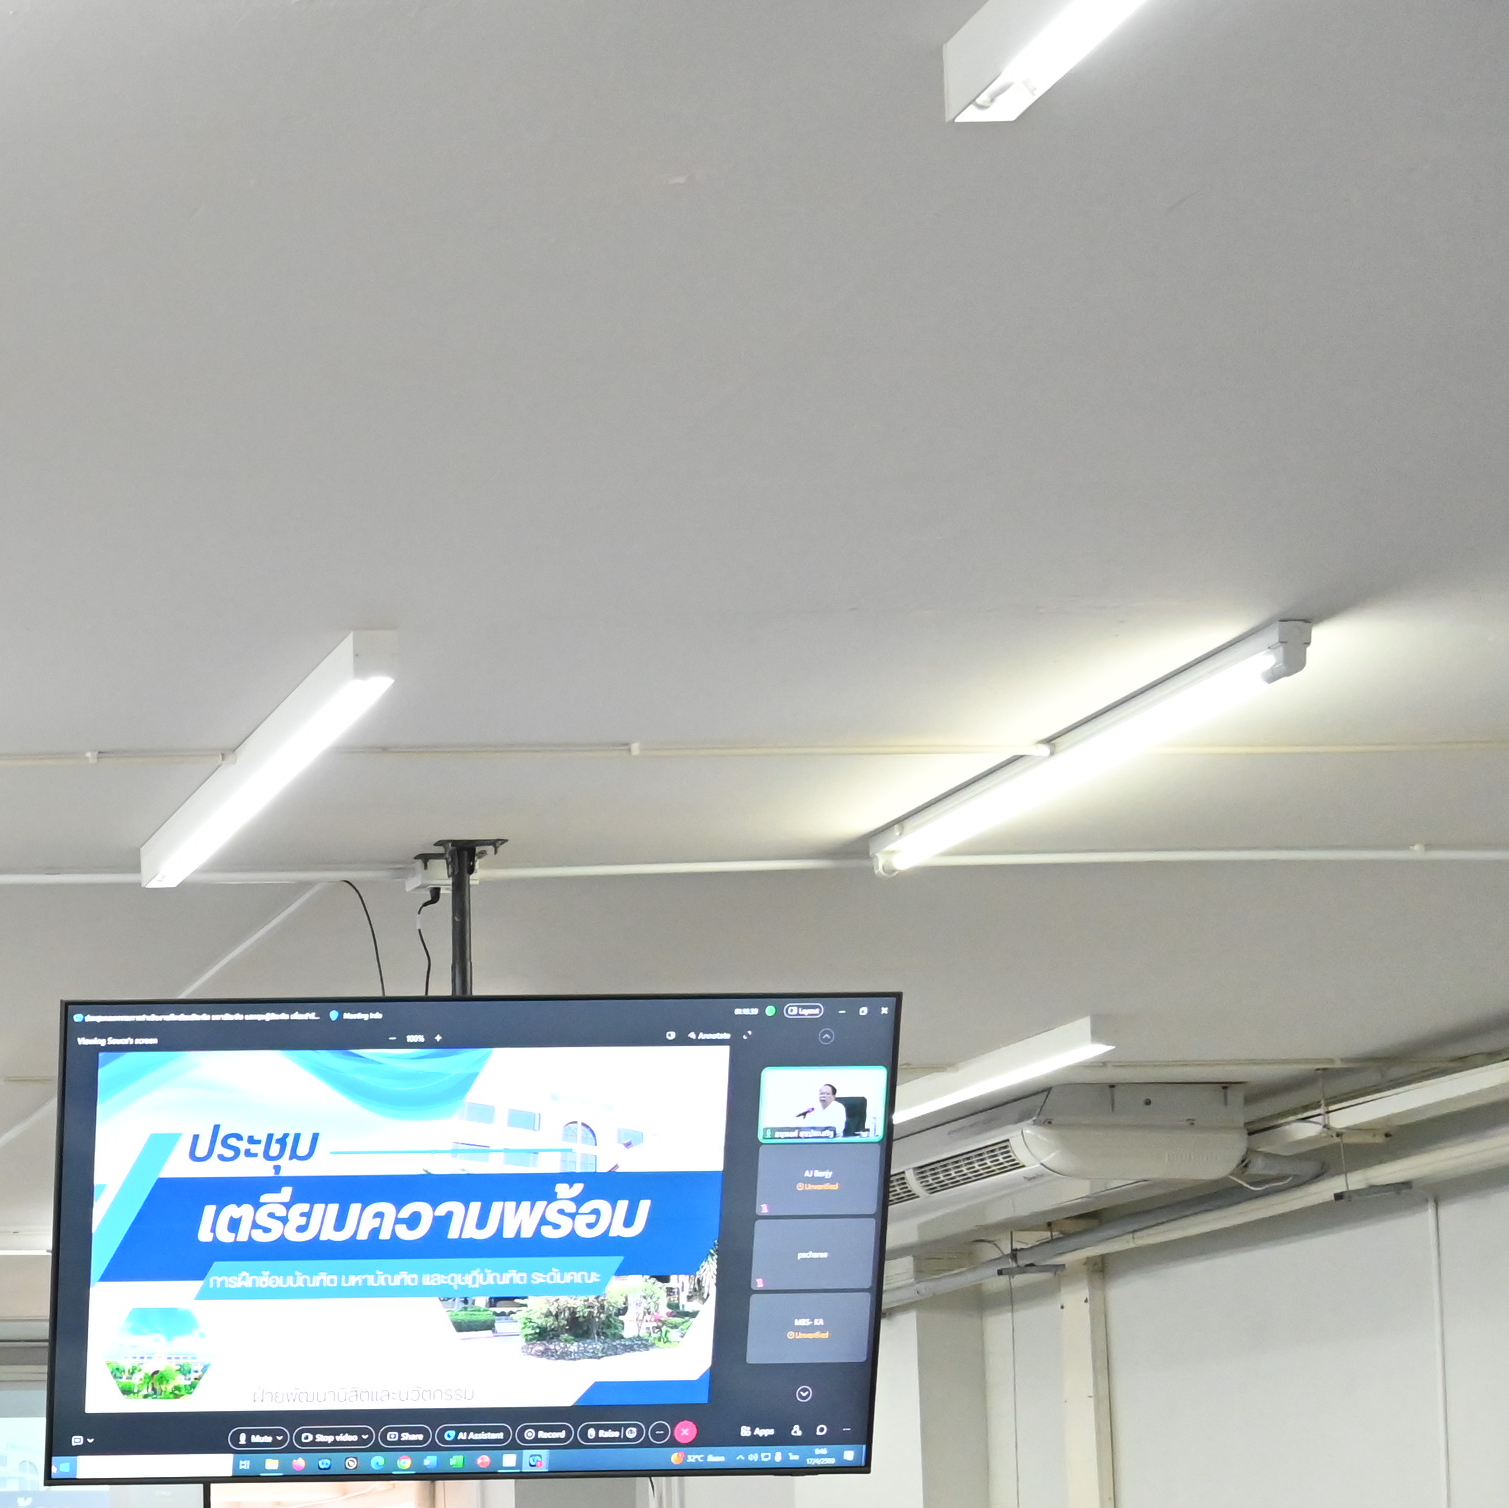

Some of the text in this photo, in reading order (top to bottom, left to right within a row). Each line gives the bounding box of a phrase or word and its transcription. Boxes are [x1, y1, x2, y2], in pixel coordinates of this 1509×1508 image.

[698, 1032, 731, 1040] Annotate
[188, 1124, 320, 1175] ประชุม
[196, 1183, 652, 1243] เตรียมความพร้อม
[209, 1266, 602, 1289] การฝึกซ้อมบัณฑิต มหาบัณฑิต และดุษฎีบัณฑิต ระดับคณะ
[401, 1431, 423, 1441] Share
[467, 1430, 503, 1440] Assistant
[538, 1429, 565, 1439] Record
[599, 1428, 620, 1438] Raise
[754, 1426, 774, 1436] Apps
[251, 1434, 273, 1443] Mute
[315, 1432, 358, 1443] Stop video
